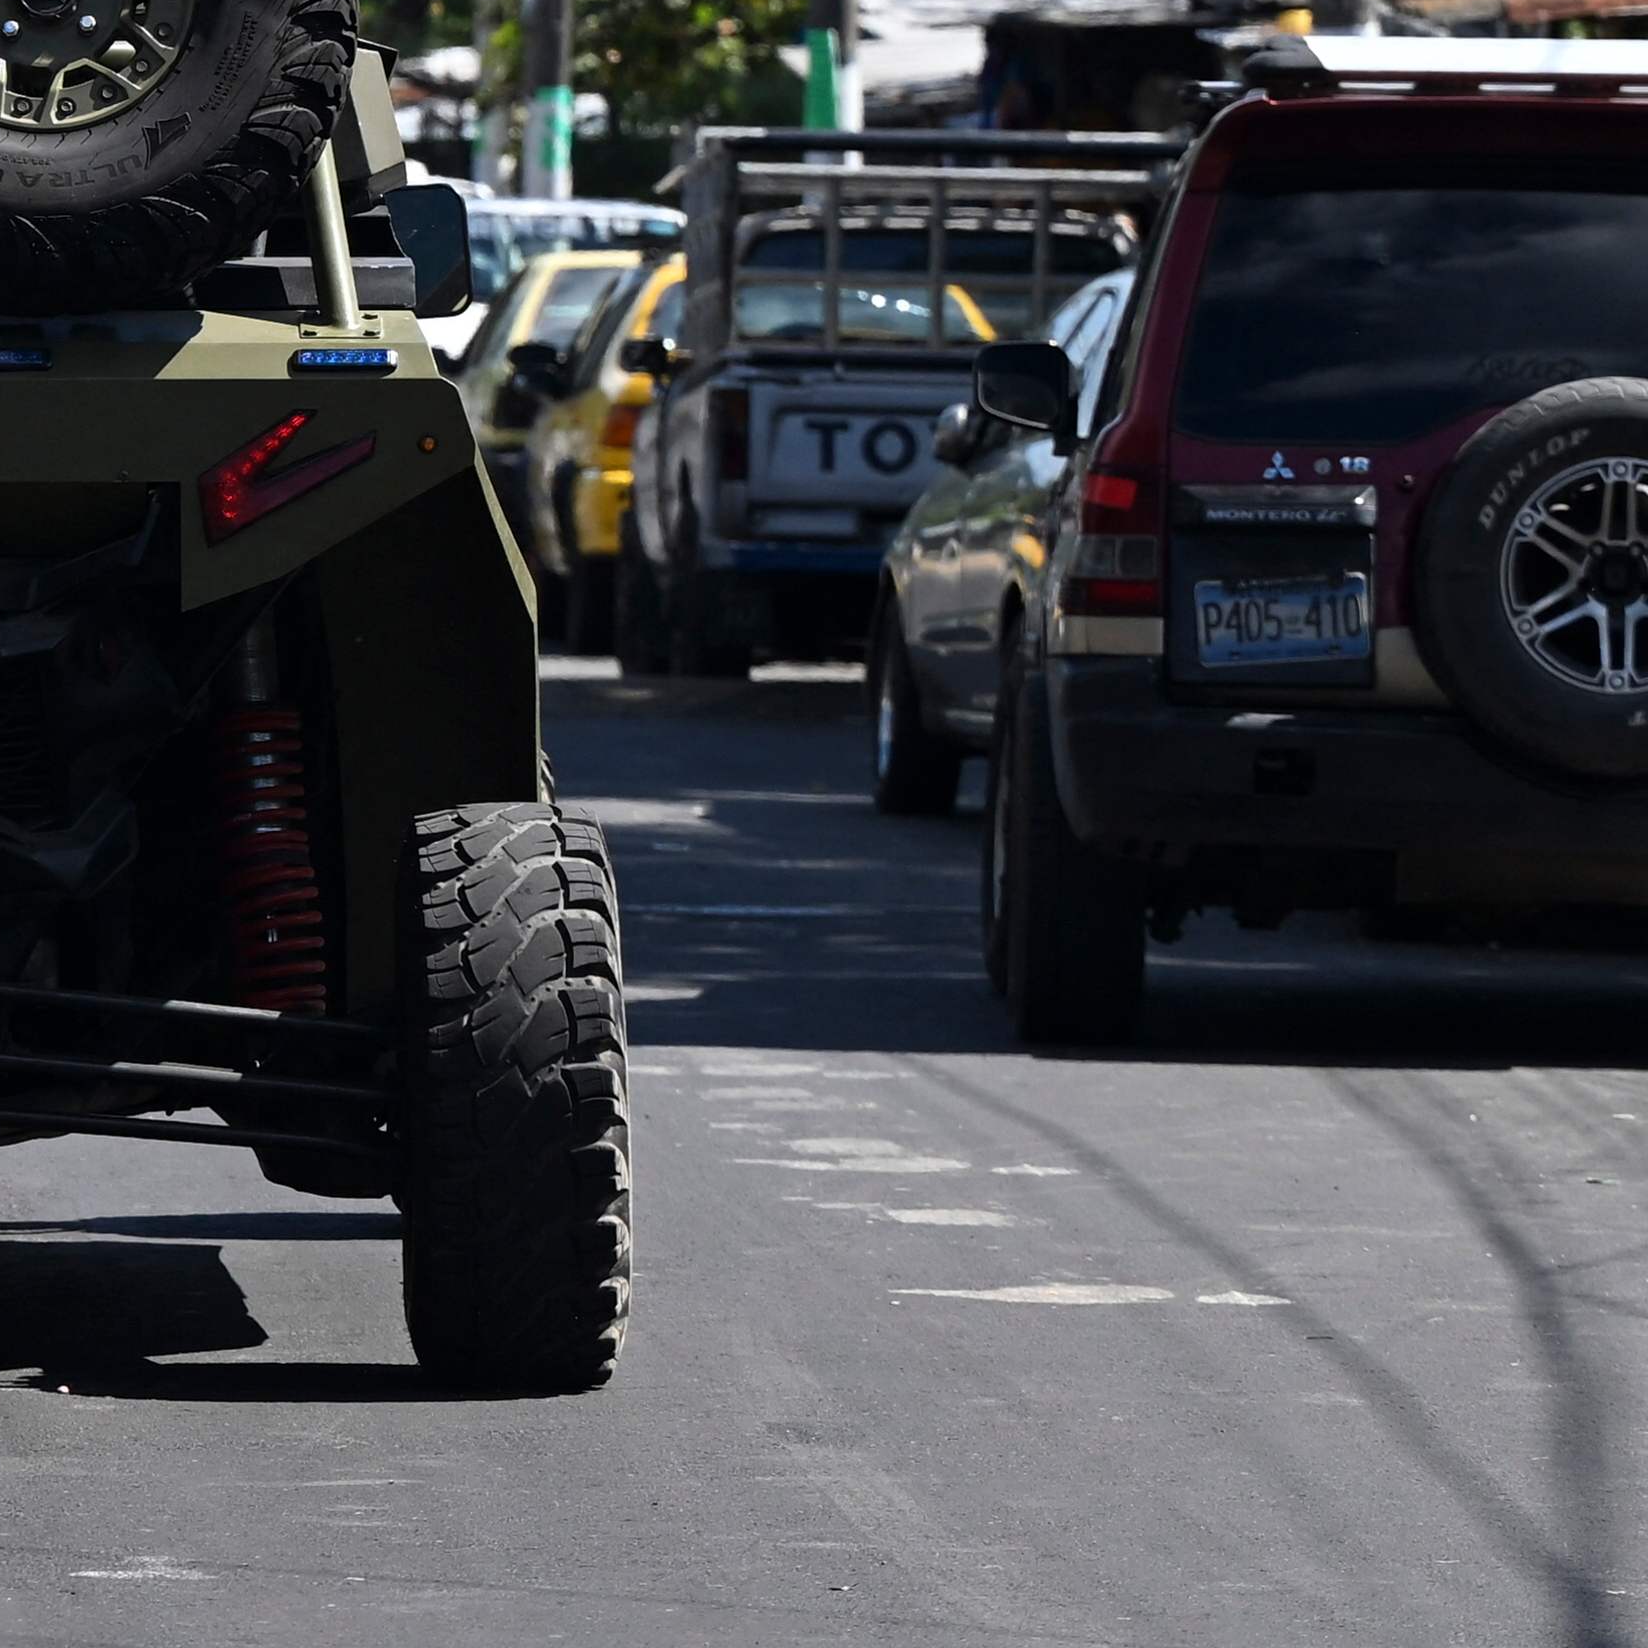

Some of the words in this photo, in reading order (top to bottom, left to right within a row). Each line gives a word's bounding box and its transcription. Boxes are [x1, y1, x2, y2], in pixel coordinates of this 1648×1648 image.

[15, 154, 145, 189] ULTRA
[1478, 428, 1591, 531] DUNLOP
[1206, 508, 1311, 521] MONTERO
